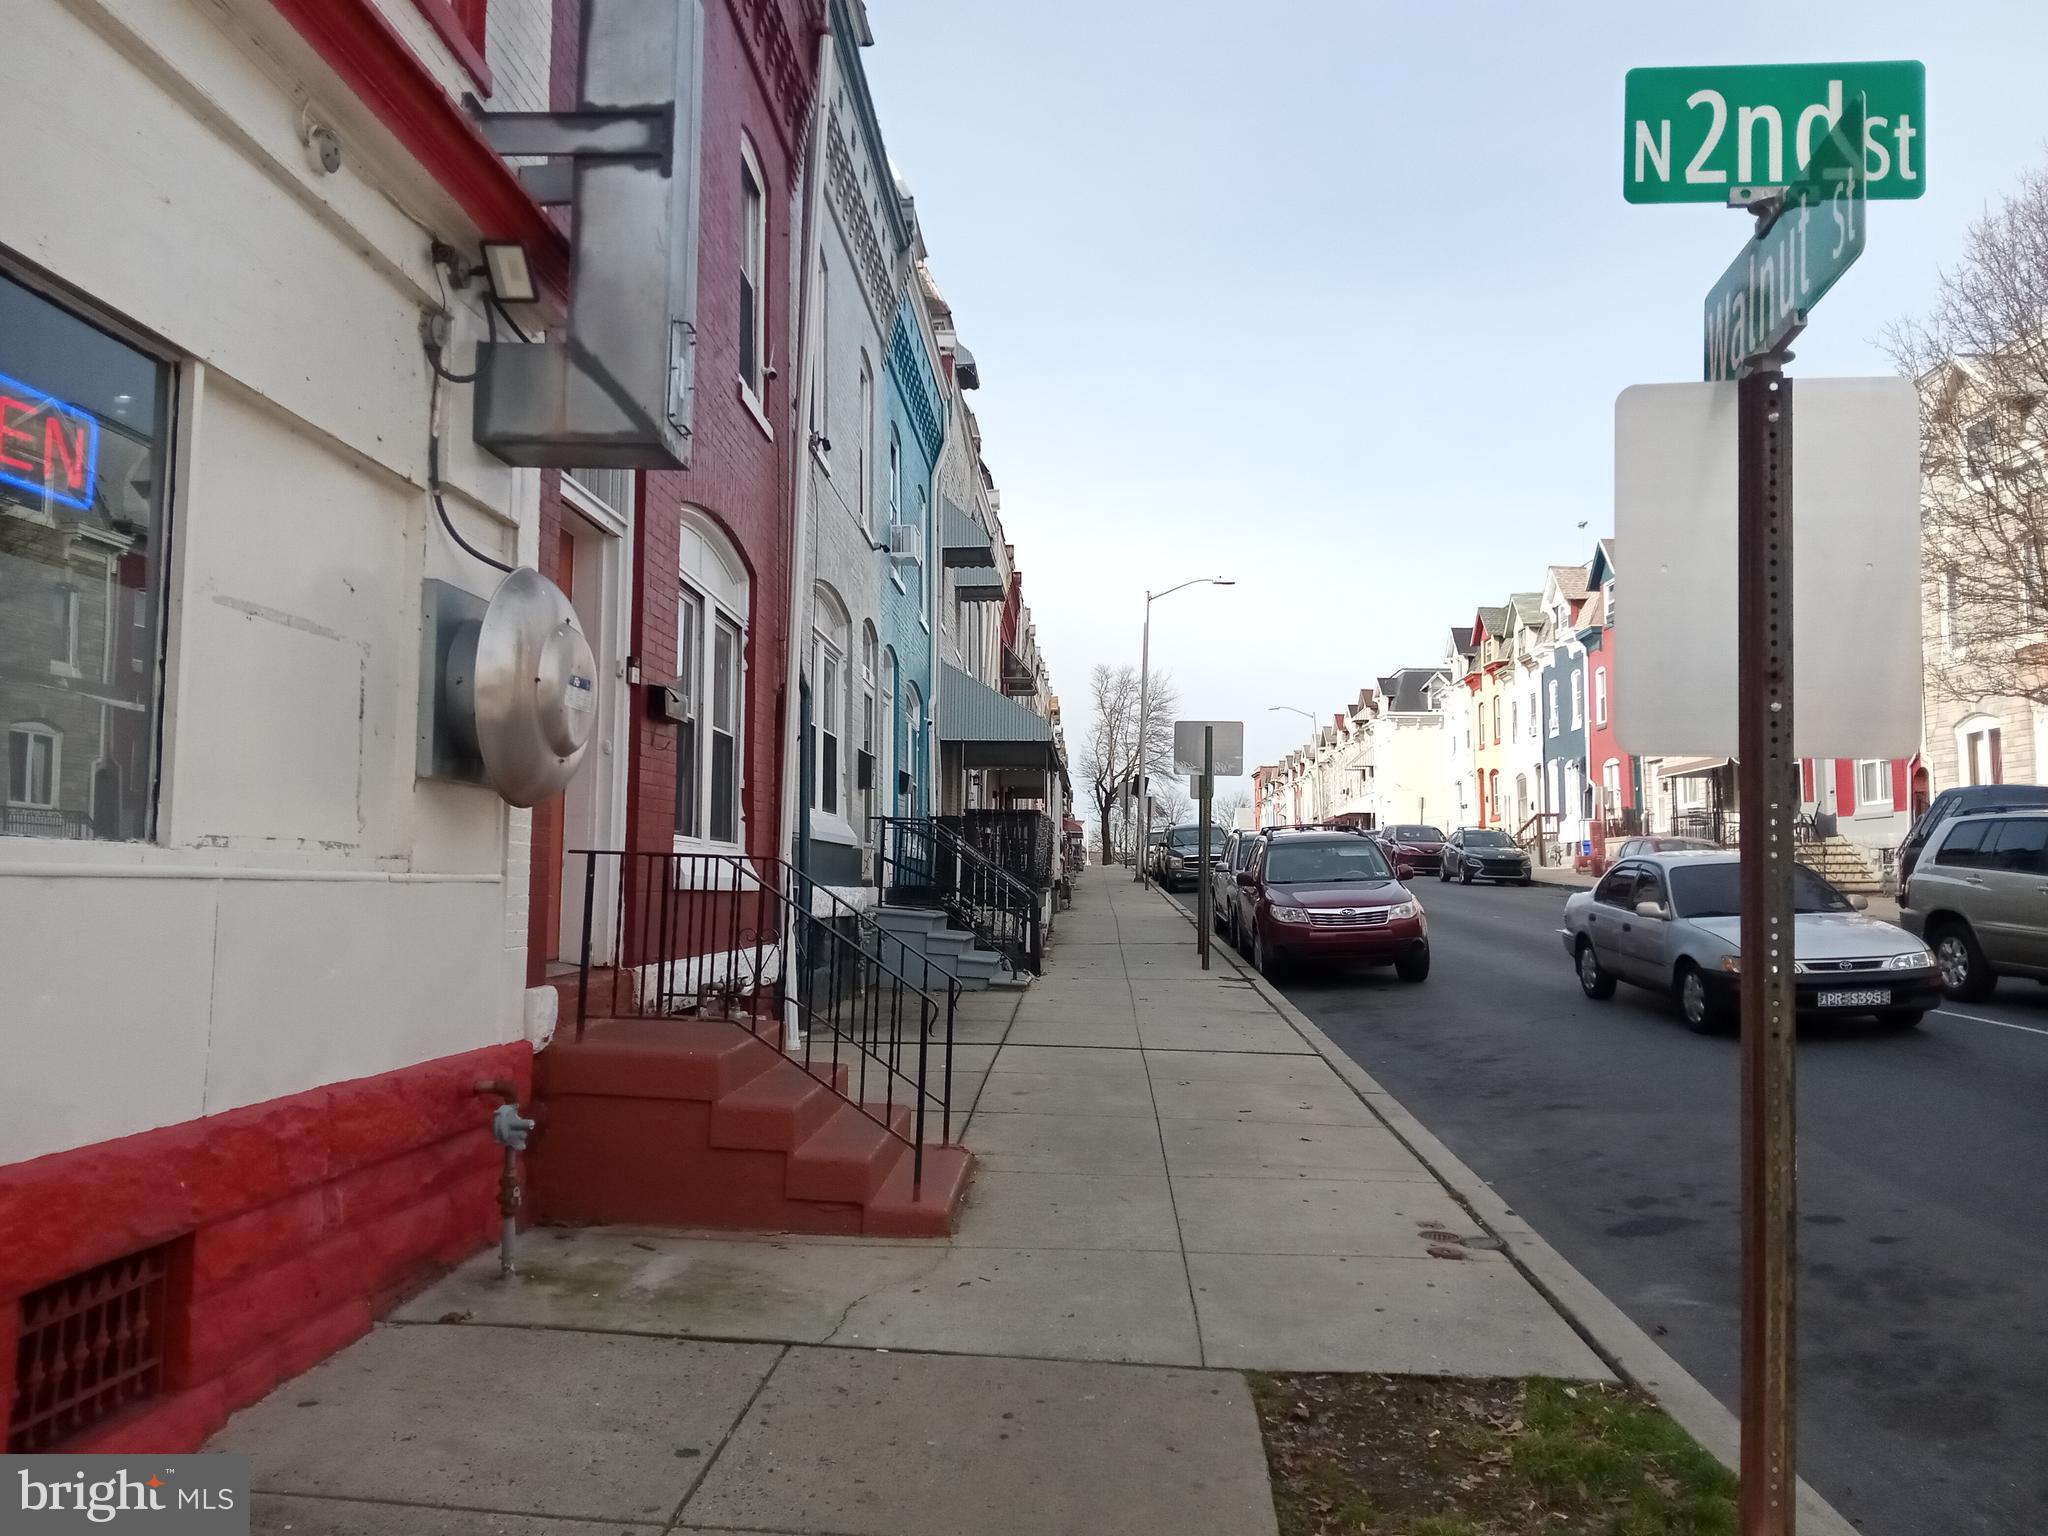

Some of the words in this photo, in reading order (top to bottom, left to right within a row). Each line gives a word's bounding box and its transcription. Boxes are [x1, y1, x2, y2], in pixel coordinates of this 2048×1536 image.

[1635, 119, 1671, 182] N
[1684, 80, 1844, 184] 2nd
[1864, 114, 1917, 181] St
